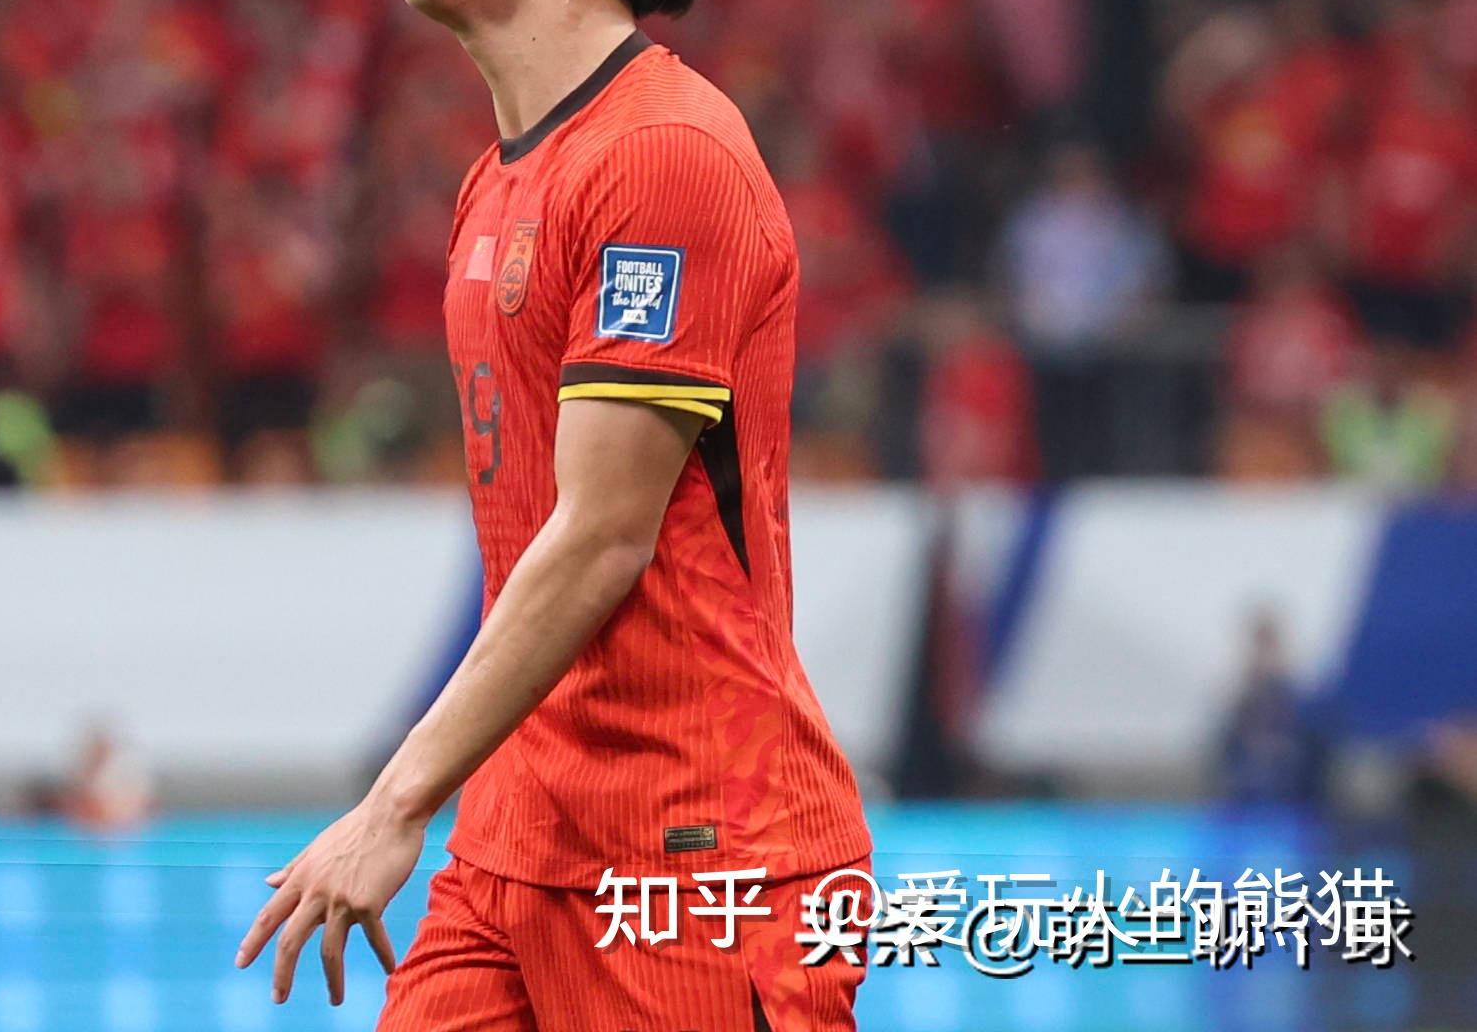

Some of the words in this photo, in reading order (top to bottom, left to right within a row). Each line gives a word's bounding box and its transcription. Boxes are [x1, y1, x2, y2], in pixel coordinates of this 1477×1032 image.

[616, 260, 664, 276] FOOTBALL
[615, 274, 664, 294] UNITES
[611, 291, 630, 307] the
[452, 362, 502, 485] 9
